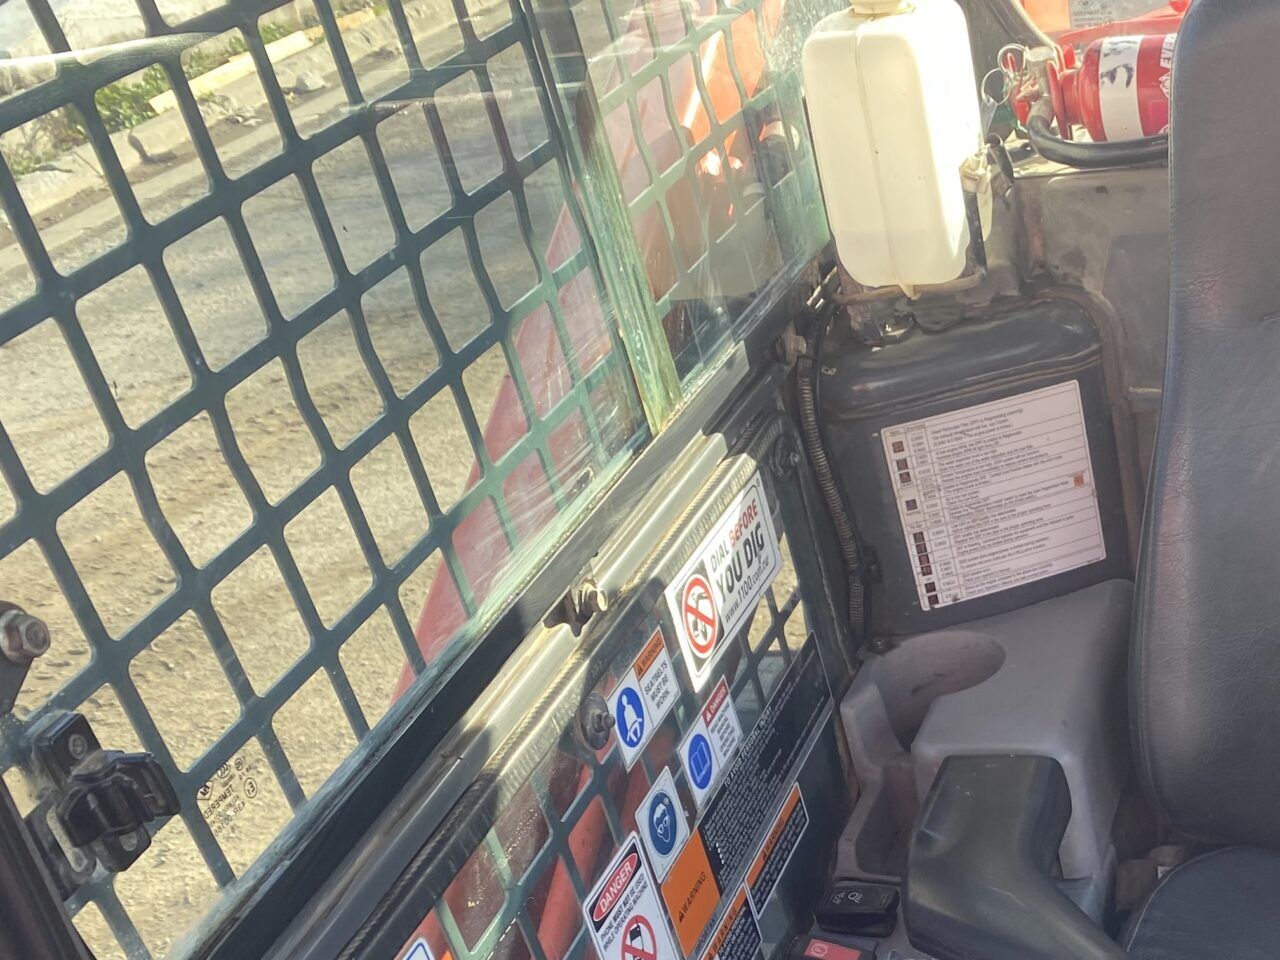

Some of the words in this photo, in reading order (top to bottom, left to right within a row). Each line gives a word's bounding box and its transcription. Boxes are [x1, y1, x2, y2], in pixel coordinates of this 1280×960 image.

[709, 538, 729, 573] DIAL
[715, 549, 745, 603] YOU
[741, 520, 766, 568] DIG
[644, 658, 667, 696] SEATBELTS
[650, 680, 662, 703] MUST
[661, 672, 668, 686] BE
[709, 684, 726, 714] DANGER
[599, 859, 632, 914] DANGER
[680, 869, 706, 916] WARNING
[612, 903, 623, 924] MUST
[622, 893, 630, 908] NOT
